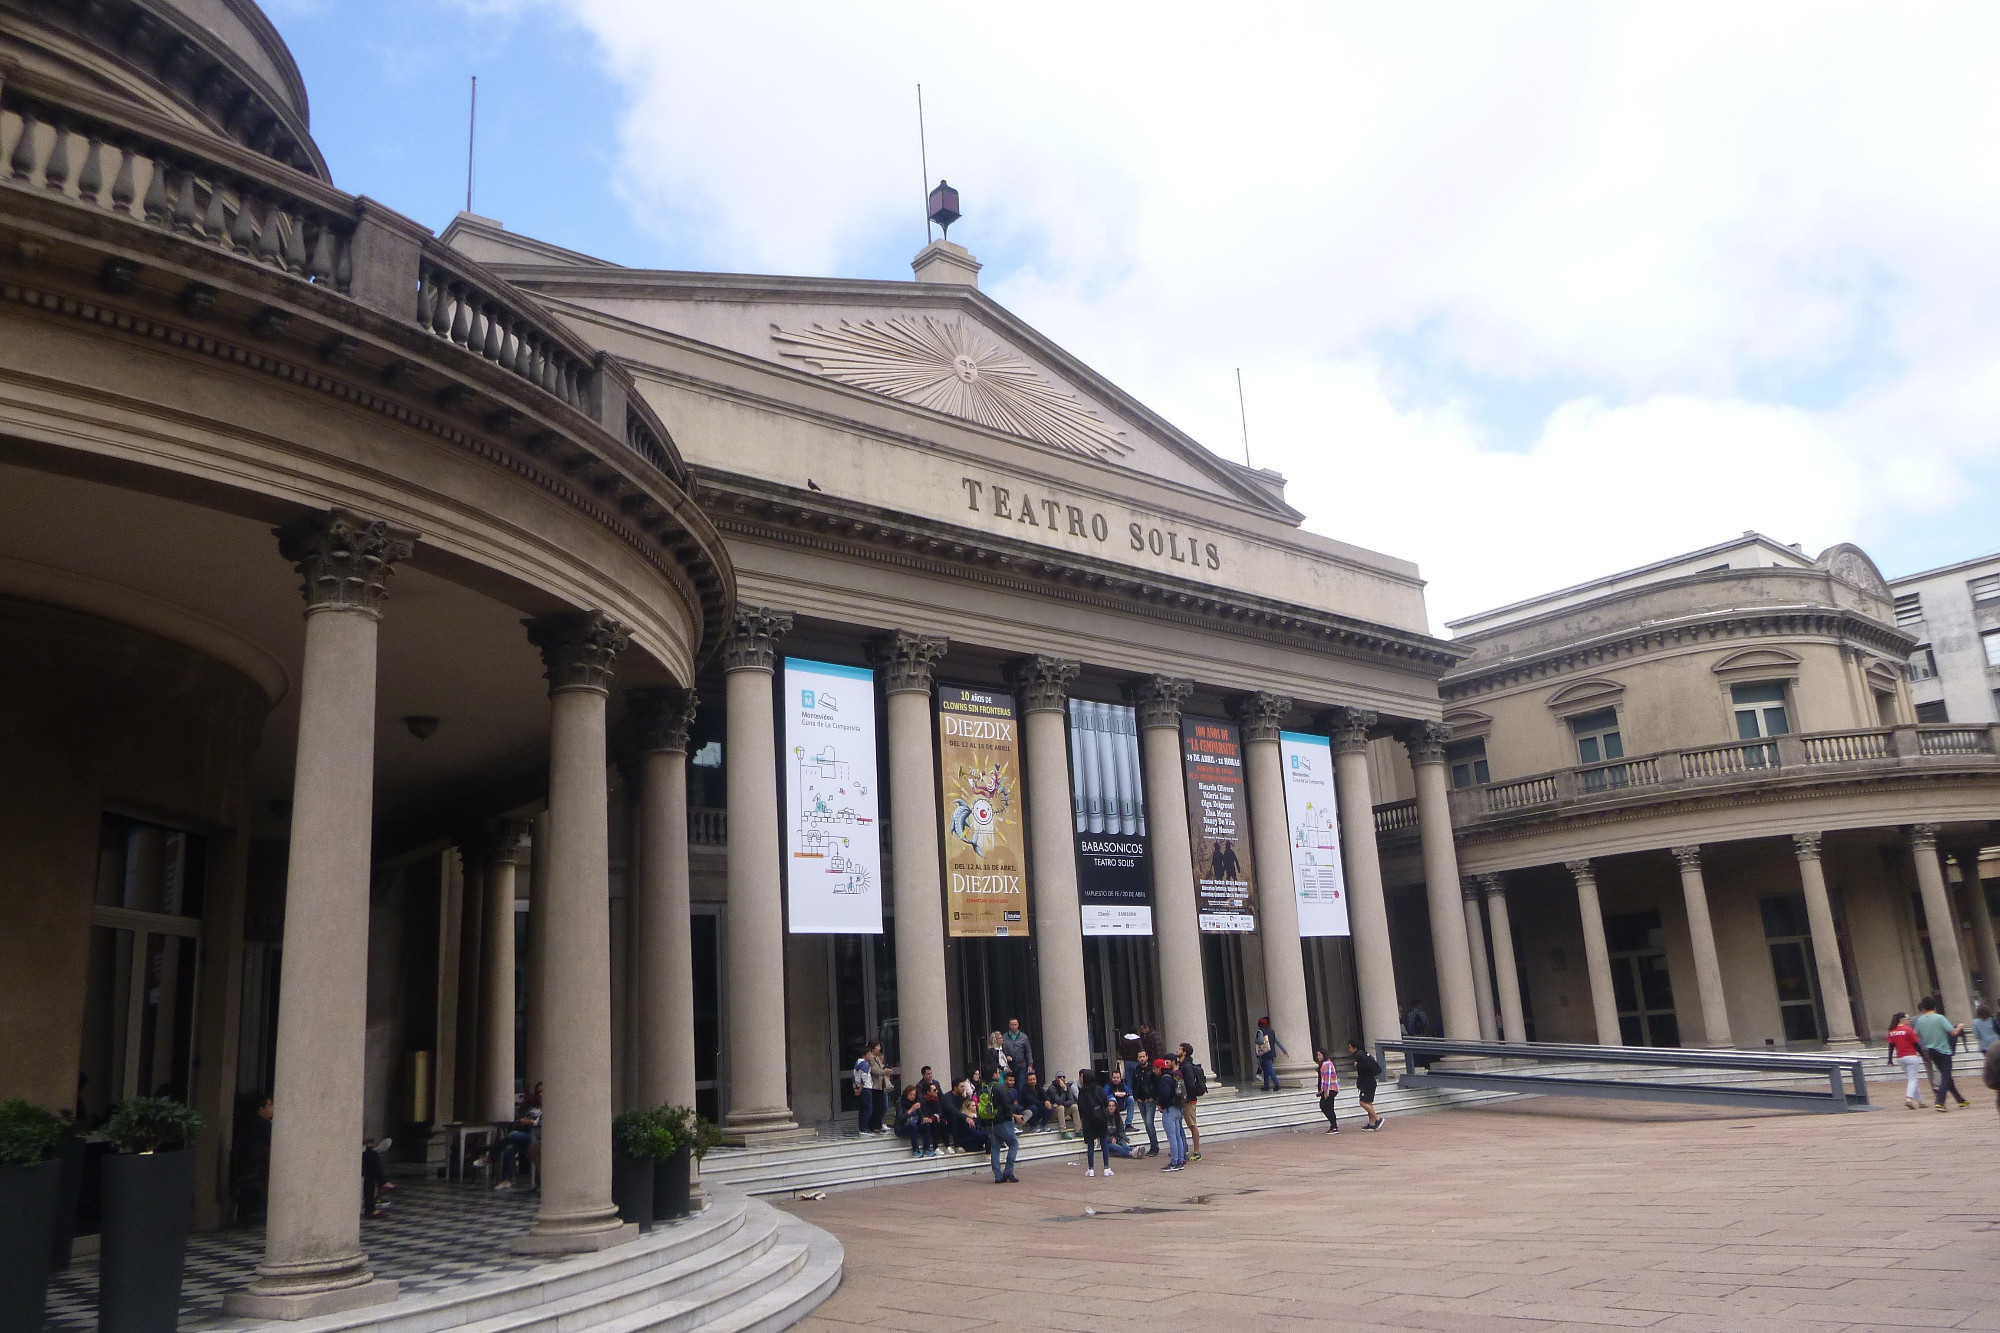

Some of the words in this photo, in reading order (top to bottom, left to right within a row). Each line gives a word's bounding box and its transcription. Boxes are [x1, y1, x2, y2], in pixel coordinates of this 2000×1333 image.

[962, 477, 1108, 542] TEATRO
[1129, 522, 1221, 570] SOLIS
[961, 690, 970, 701] 10
[971, 693, 984, 702] AÑOS
[943, 701, 968, 712] CLOWNS
[968, 704, 978, 712] SIN
[980, 706, 1012, 716] FRONTERAS
[802, 712, 834, 720] Montevideo
[832, 722, 860, 732] Cumparsita
[945, 716, 1012, 742] DIEZDIX
[1195, 726, 1206, 737] 100
[1207, 726, 1220, 740] AÑOS
[1220, 729, 1228, 740] DE
[1193, 754, 1200, 762] DE
[1224, 758, 1240, 766] HORAS
[1198, 782, 1216, 791] Ricardo
[1217, 784, 1234, 792] Olivera
[1202, 791, 1218, 800] Valeria
[1201, 800, 1212, 808] Olga
[1205, 809, 1216, 817] Elsa
[1082, 841, 1143, 854] BABASONICOS
[1094, 858, 1116, 866] TEATRO
[1118, 859, 1134, 868] SOLIS
[952, 874, 1020, 894] DIEZDIX
